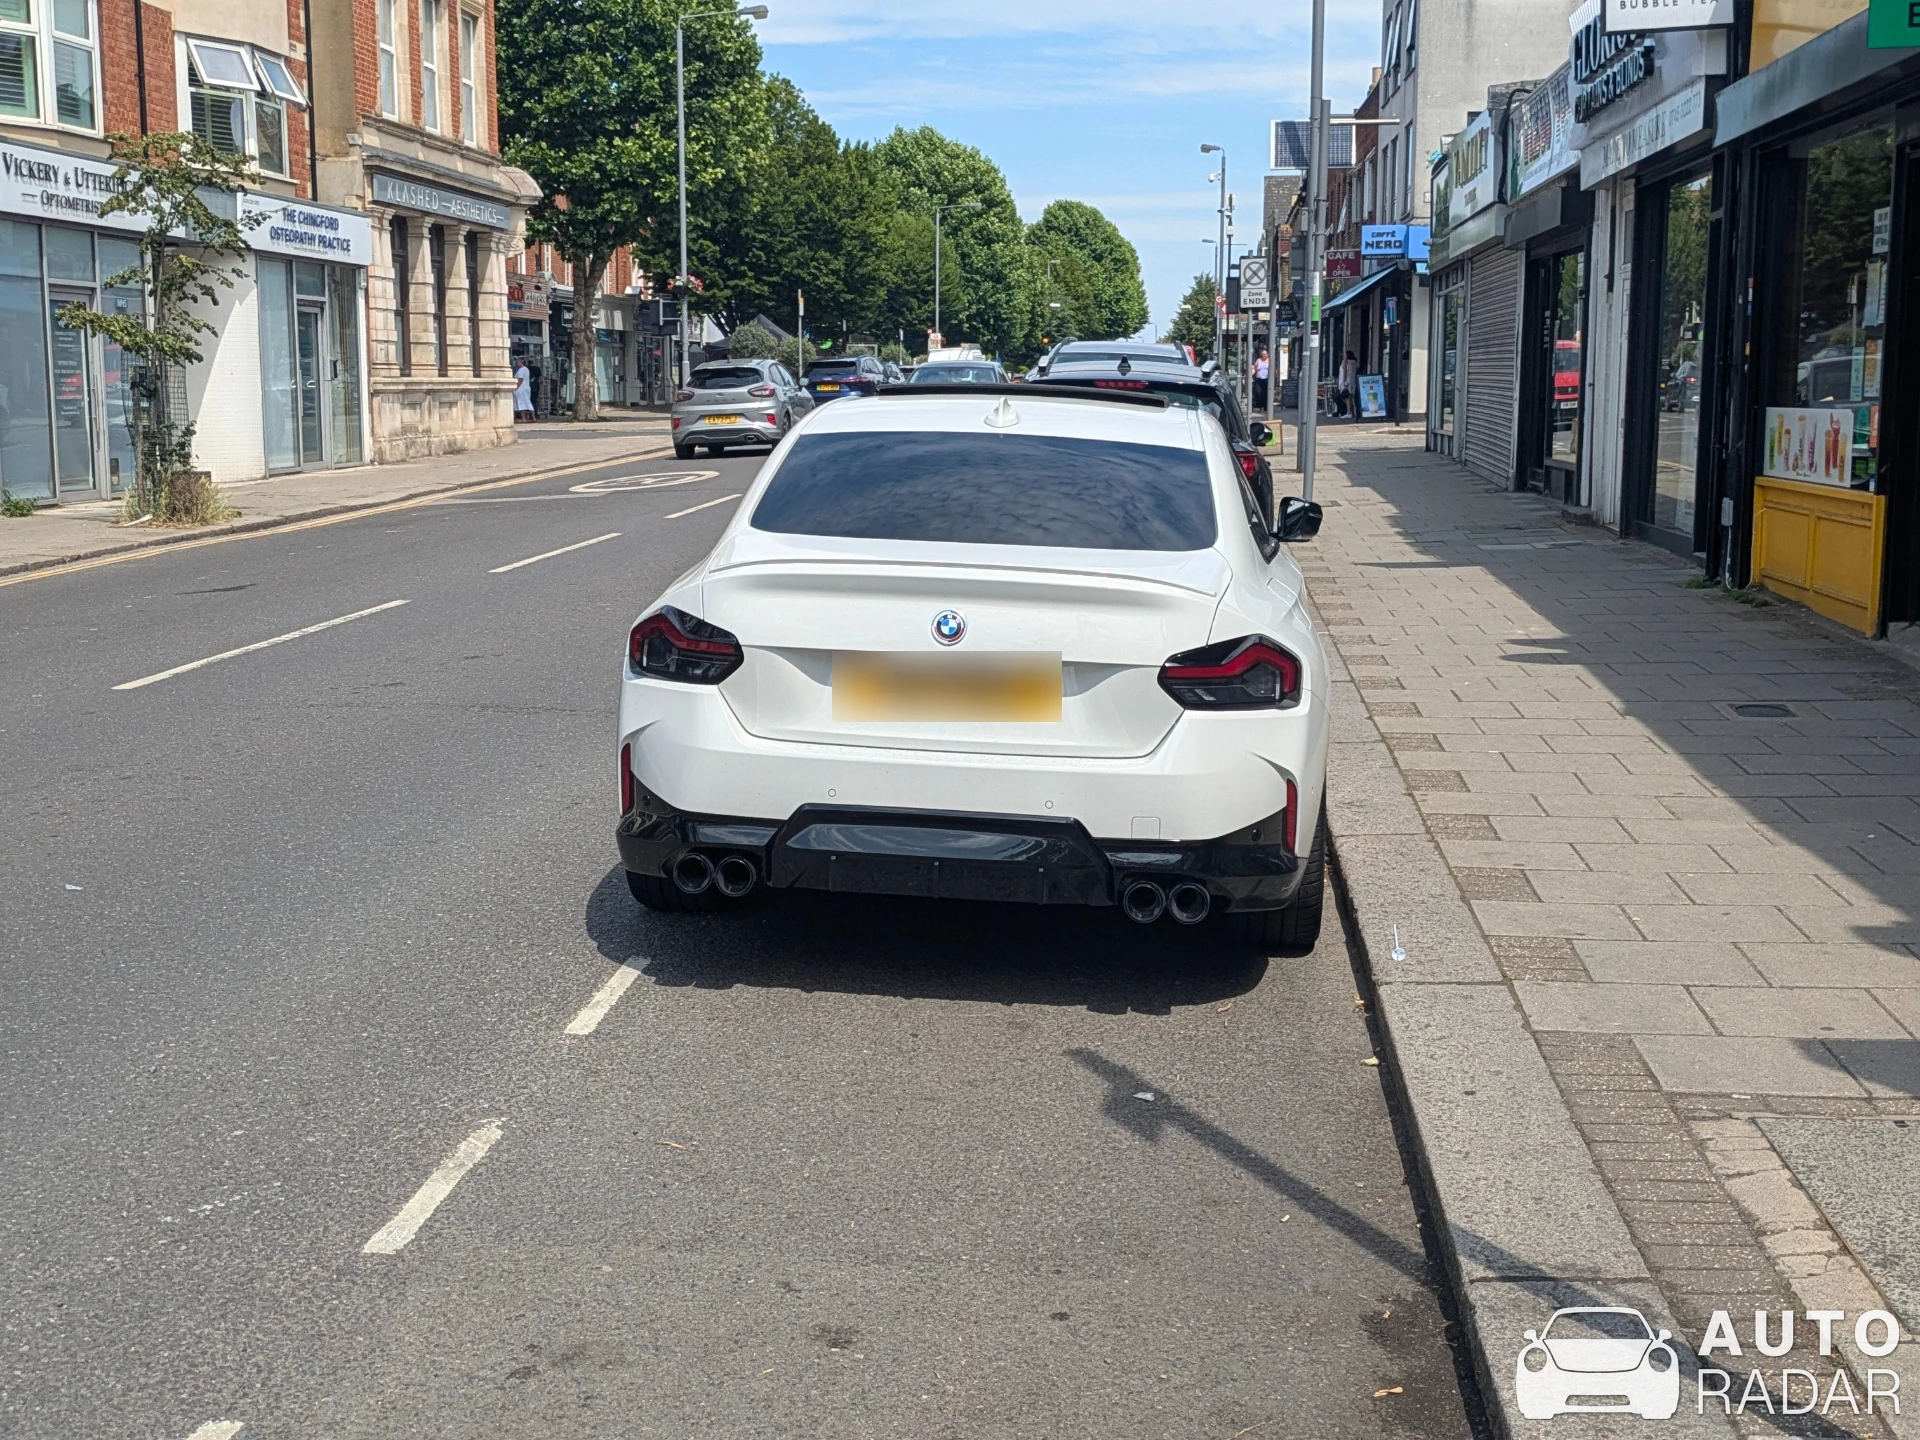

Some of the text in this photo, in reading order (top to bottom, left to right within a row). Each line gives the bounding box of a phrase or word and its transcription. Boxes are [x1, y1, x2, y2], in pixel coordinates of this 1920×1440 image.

[1616, 50, 1645, 95] BLINDS
[2, 152, 60, 183] VICKERY
[64, 171, 71, 185] &
[41, 189, 104, 214] OPTOMETRIS
[387, 180, 497, 223] KLASHED AESTHETICS
[282, 207, 339, 231] THE CHINGFORD
[270, 226, 317, 247] OSTEOPATHY
[318, 234, 351, 252] PRACTICE
[1365, 240, 1403, 250] NERO
[117, 299, 128, 308] NHS
